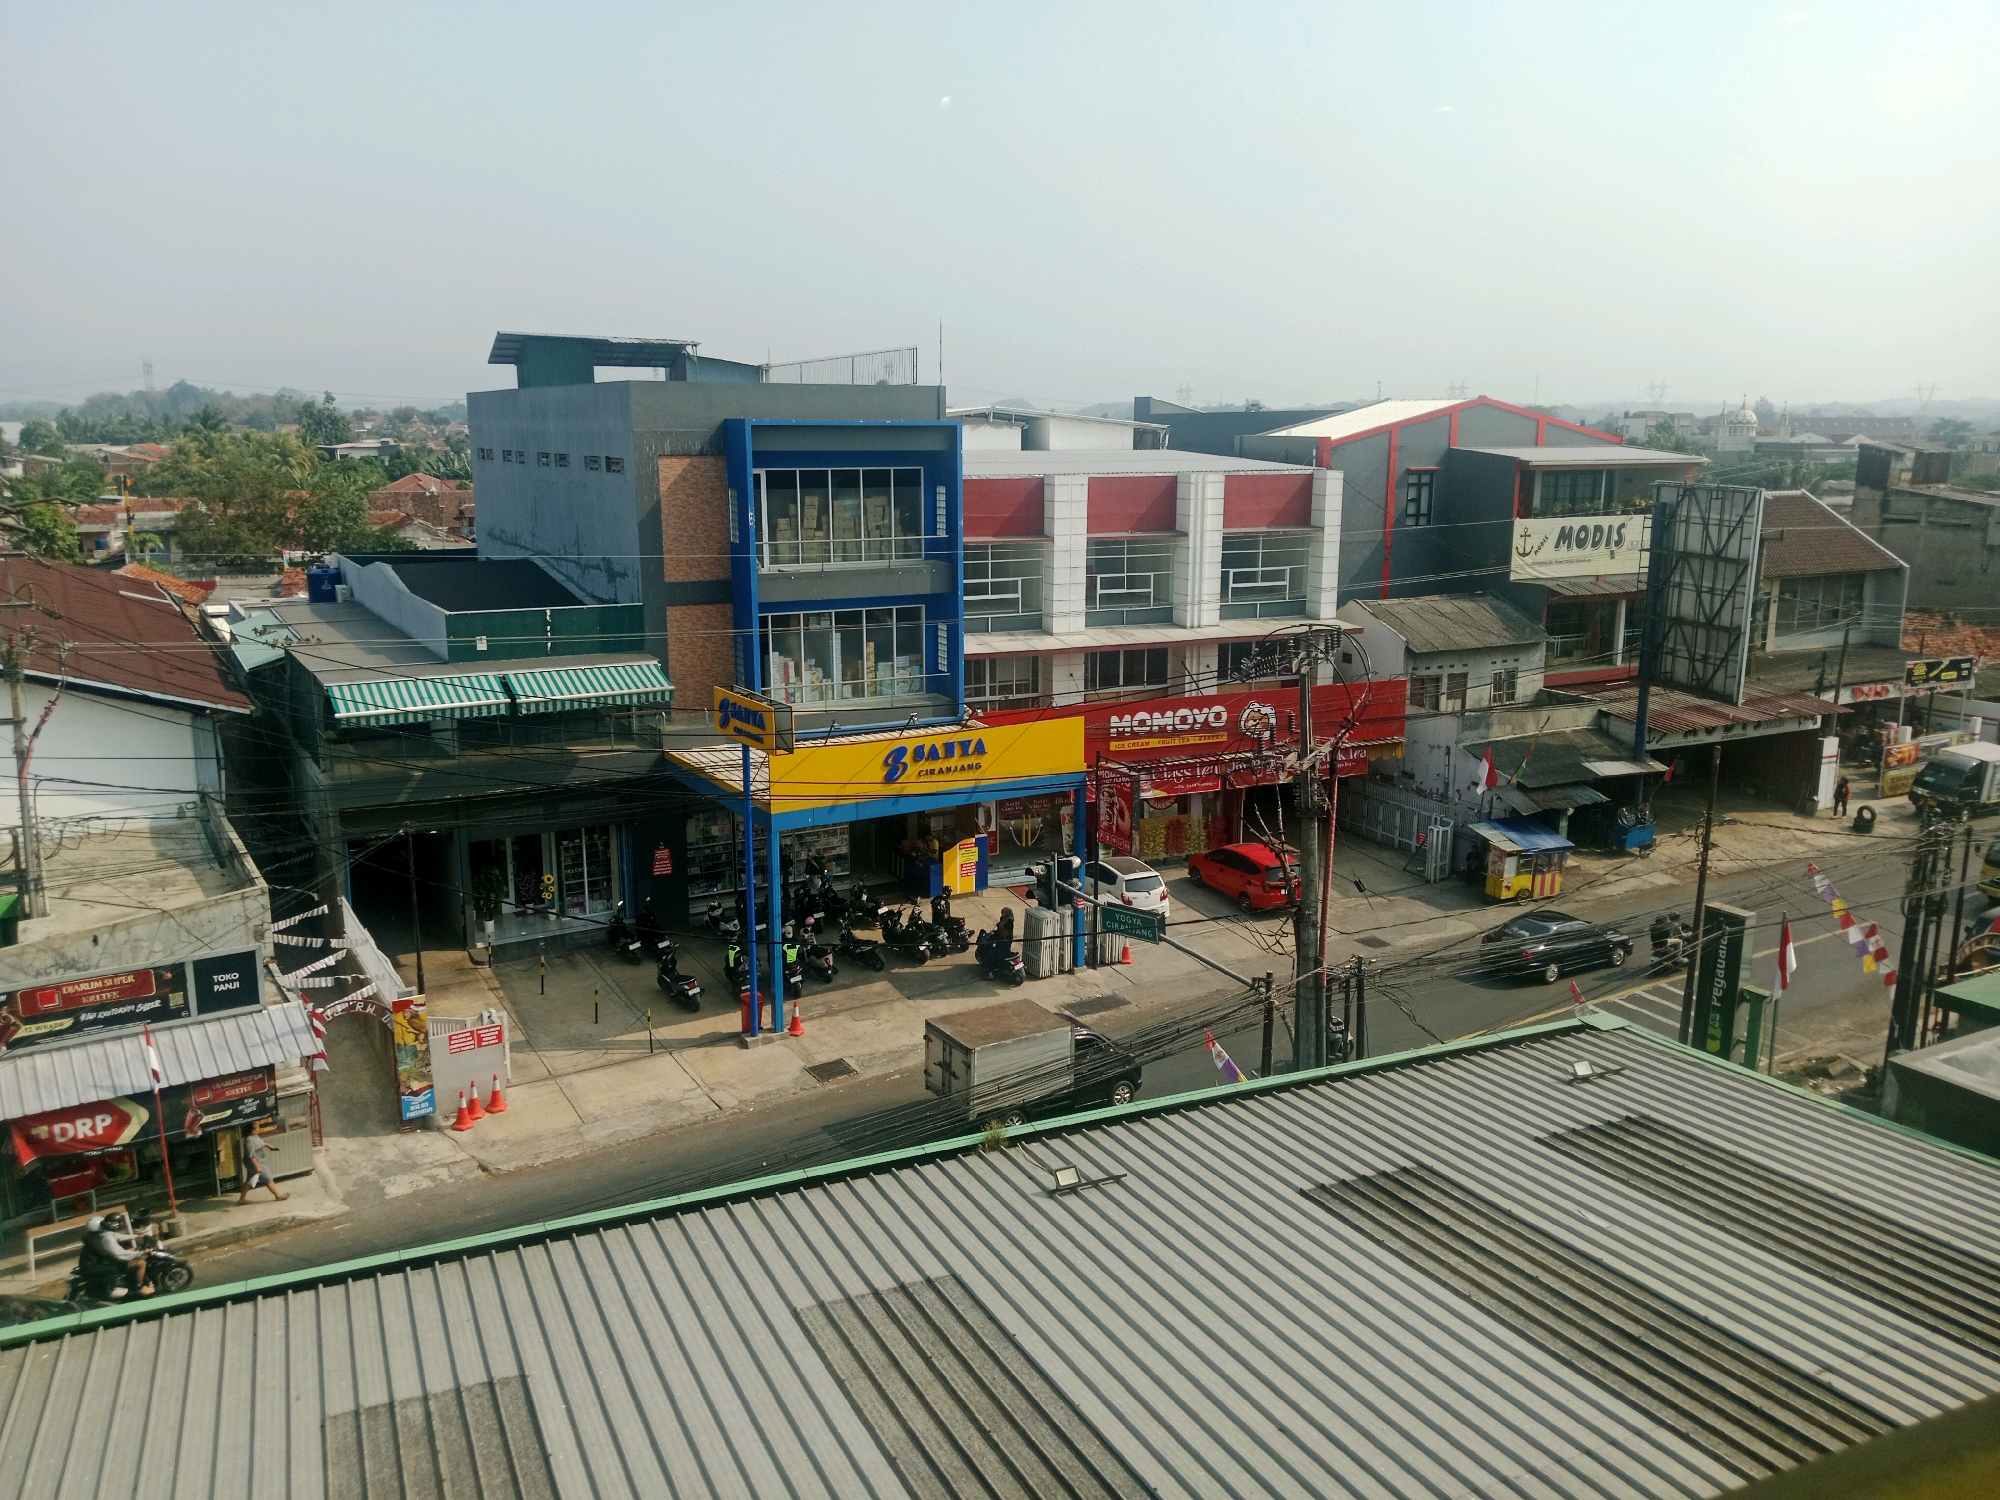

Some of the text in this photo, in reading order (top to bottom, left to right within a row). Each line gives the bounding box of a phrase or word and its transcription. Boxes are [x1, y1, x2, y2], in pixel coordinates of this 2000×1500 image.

[1534, 535, 1548, 556] MODIS
[1554, 523, 1625, 551] MODIS
[1110, 705, 1228, 737] MOMOYO
[913, 737, 988, 763] SANYA
[1127, 741, 1150, 749] CREAM
[918, 762, 982, 777] CIRANJANG
[1115, 913, 1142, 926] YOGYA
[62, 974, 135, 994] DJARUM SUPER
[213, 972, 239, 983] TOKO
[213, 982, 240, 992] PANJI
[81, 991, 120, 1003] KRETEK
[53, 1113, 112, 1143] DRP
